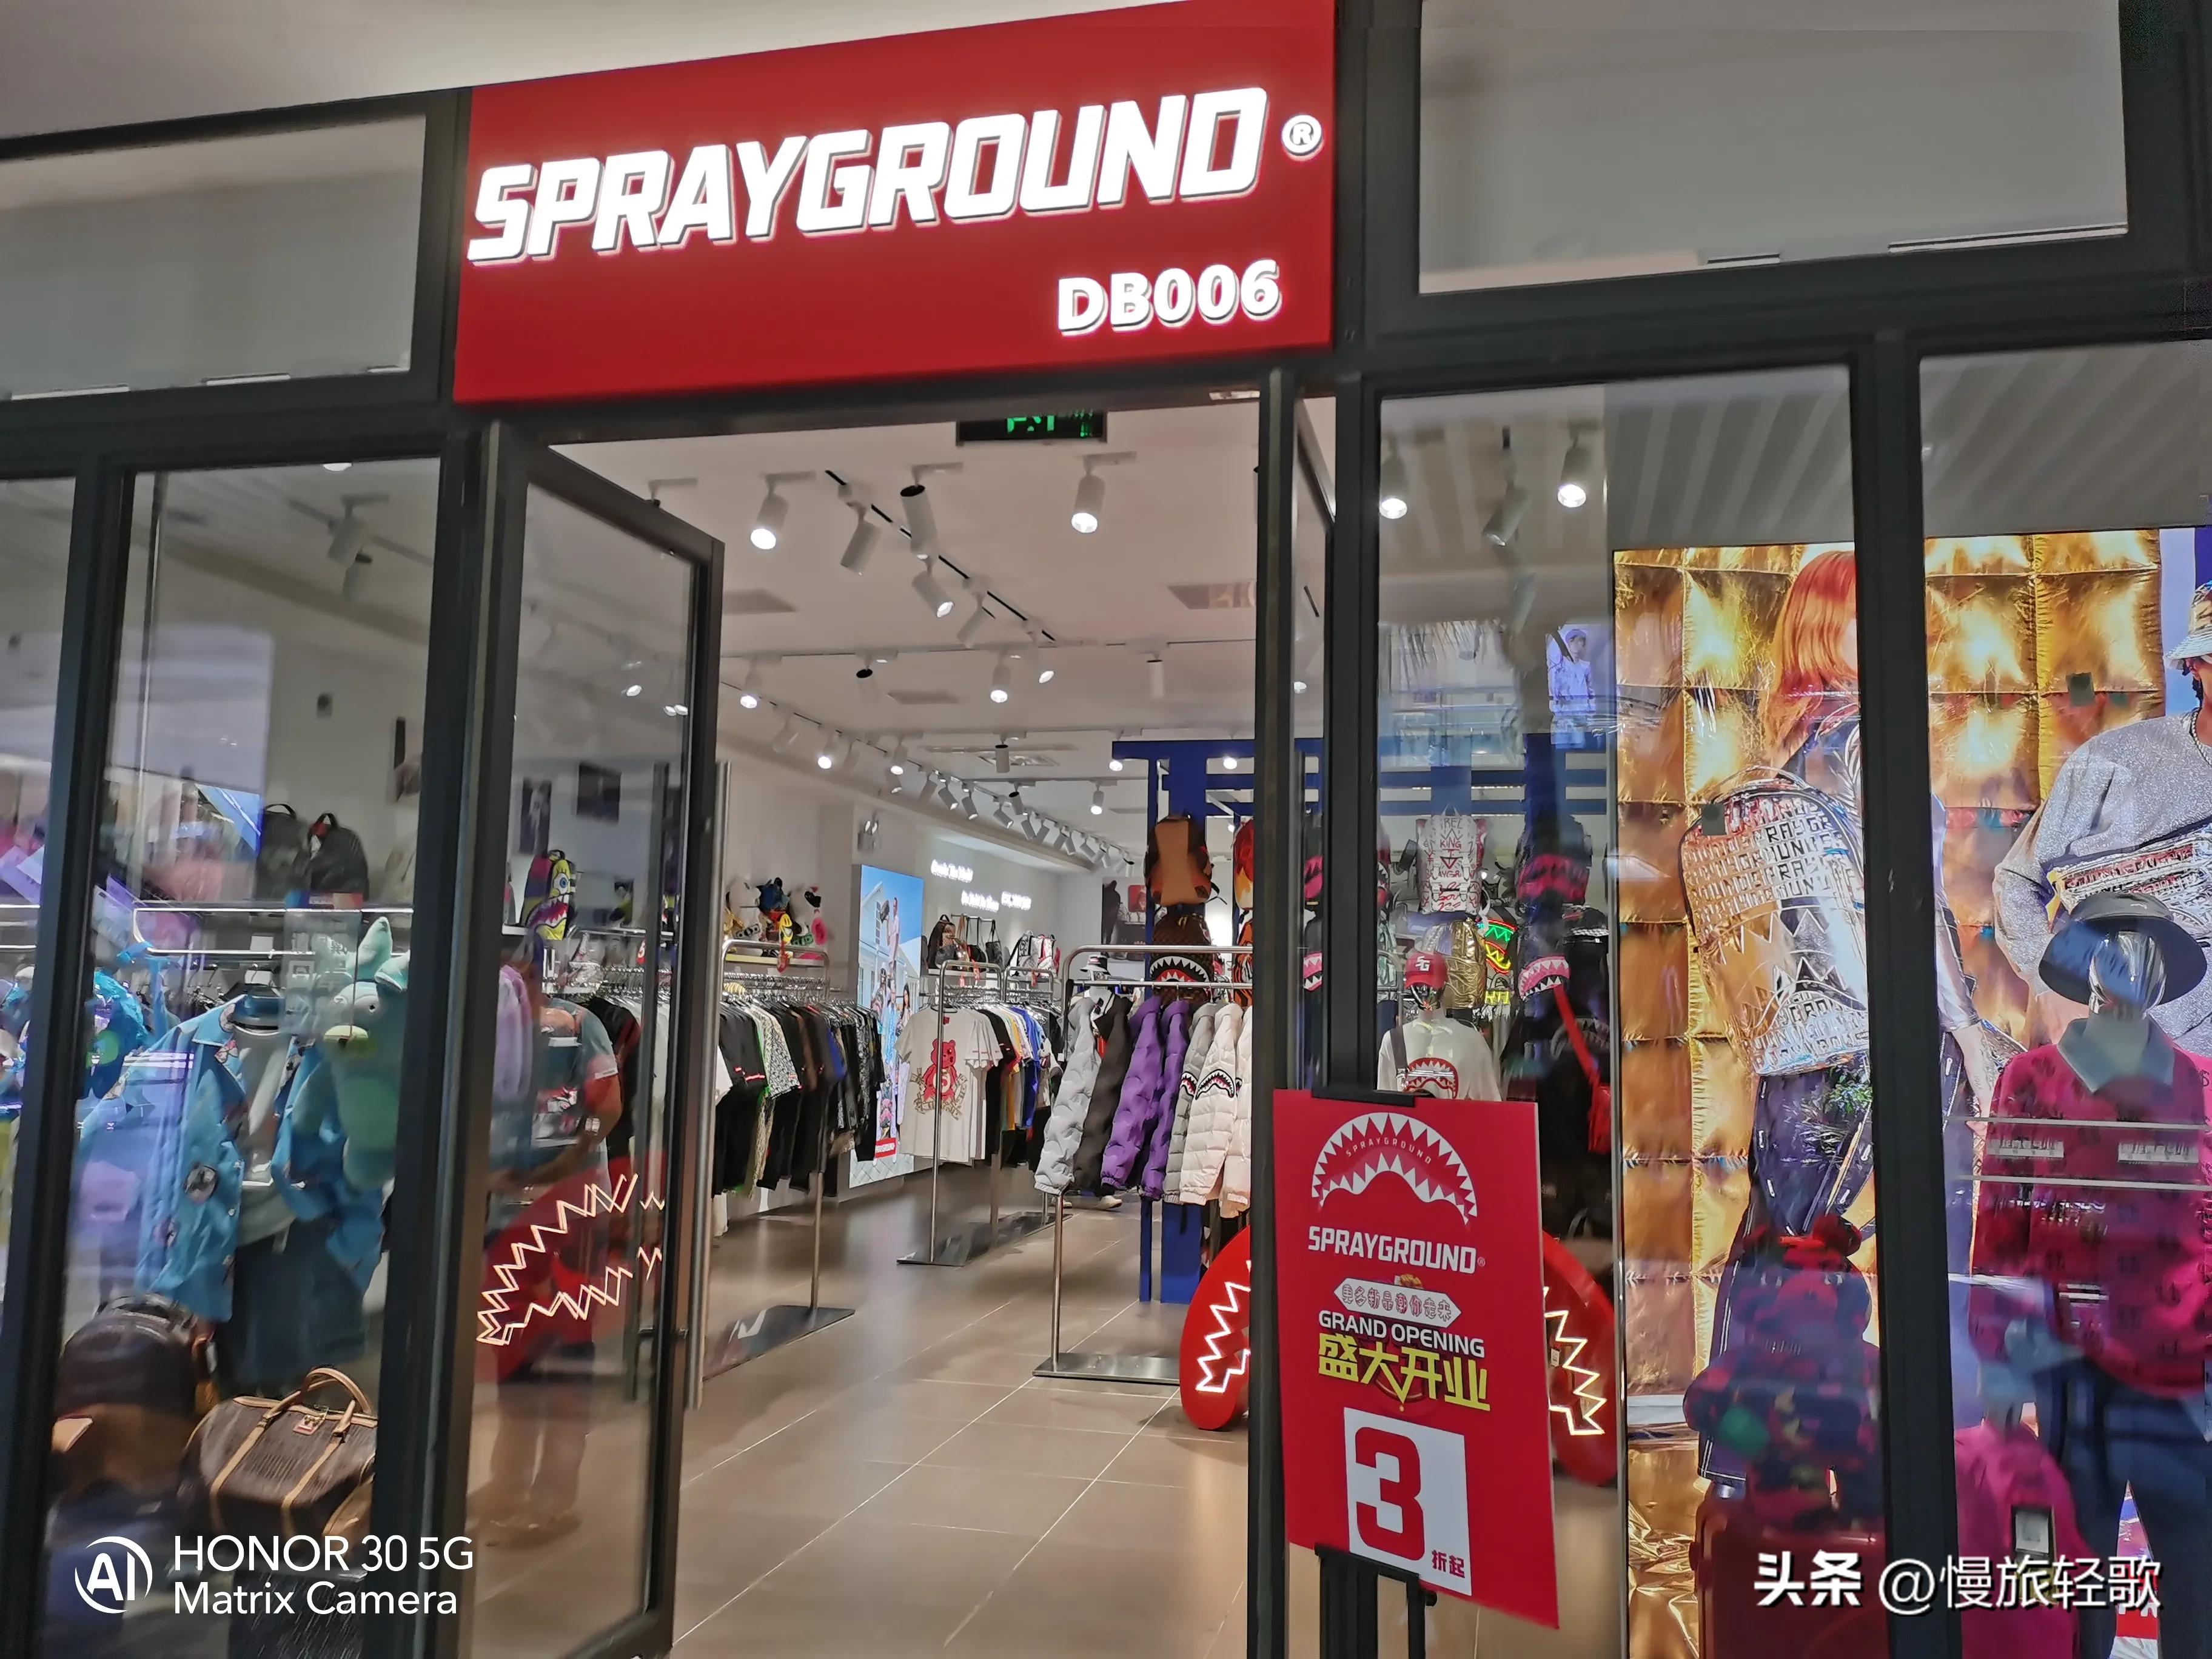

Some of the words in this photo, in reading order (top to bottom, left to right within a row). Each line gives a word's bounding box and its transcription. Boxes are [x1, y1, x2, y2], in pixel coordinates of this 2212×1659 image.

[467, 87, 1267, 266] SPRAYGROUND
[1057, 259, 1282, 336] DB006
[1346, 1137, 1432, 1164] SPRAYGROUND
[1308, 1225, 1476, 1274] SPRAYGROUND
[1318, 1333, 1490, 1412] 盛大开业
[1319, 1310, 1387, 1338] GRAND
[1391, 1323, 1485, 1358] OPENING
[1355, 1427, 1425, 1561] 3
[1432, 1549, 1465, 1579] 折起
